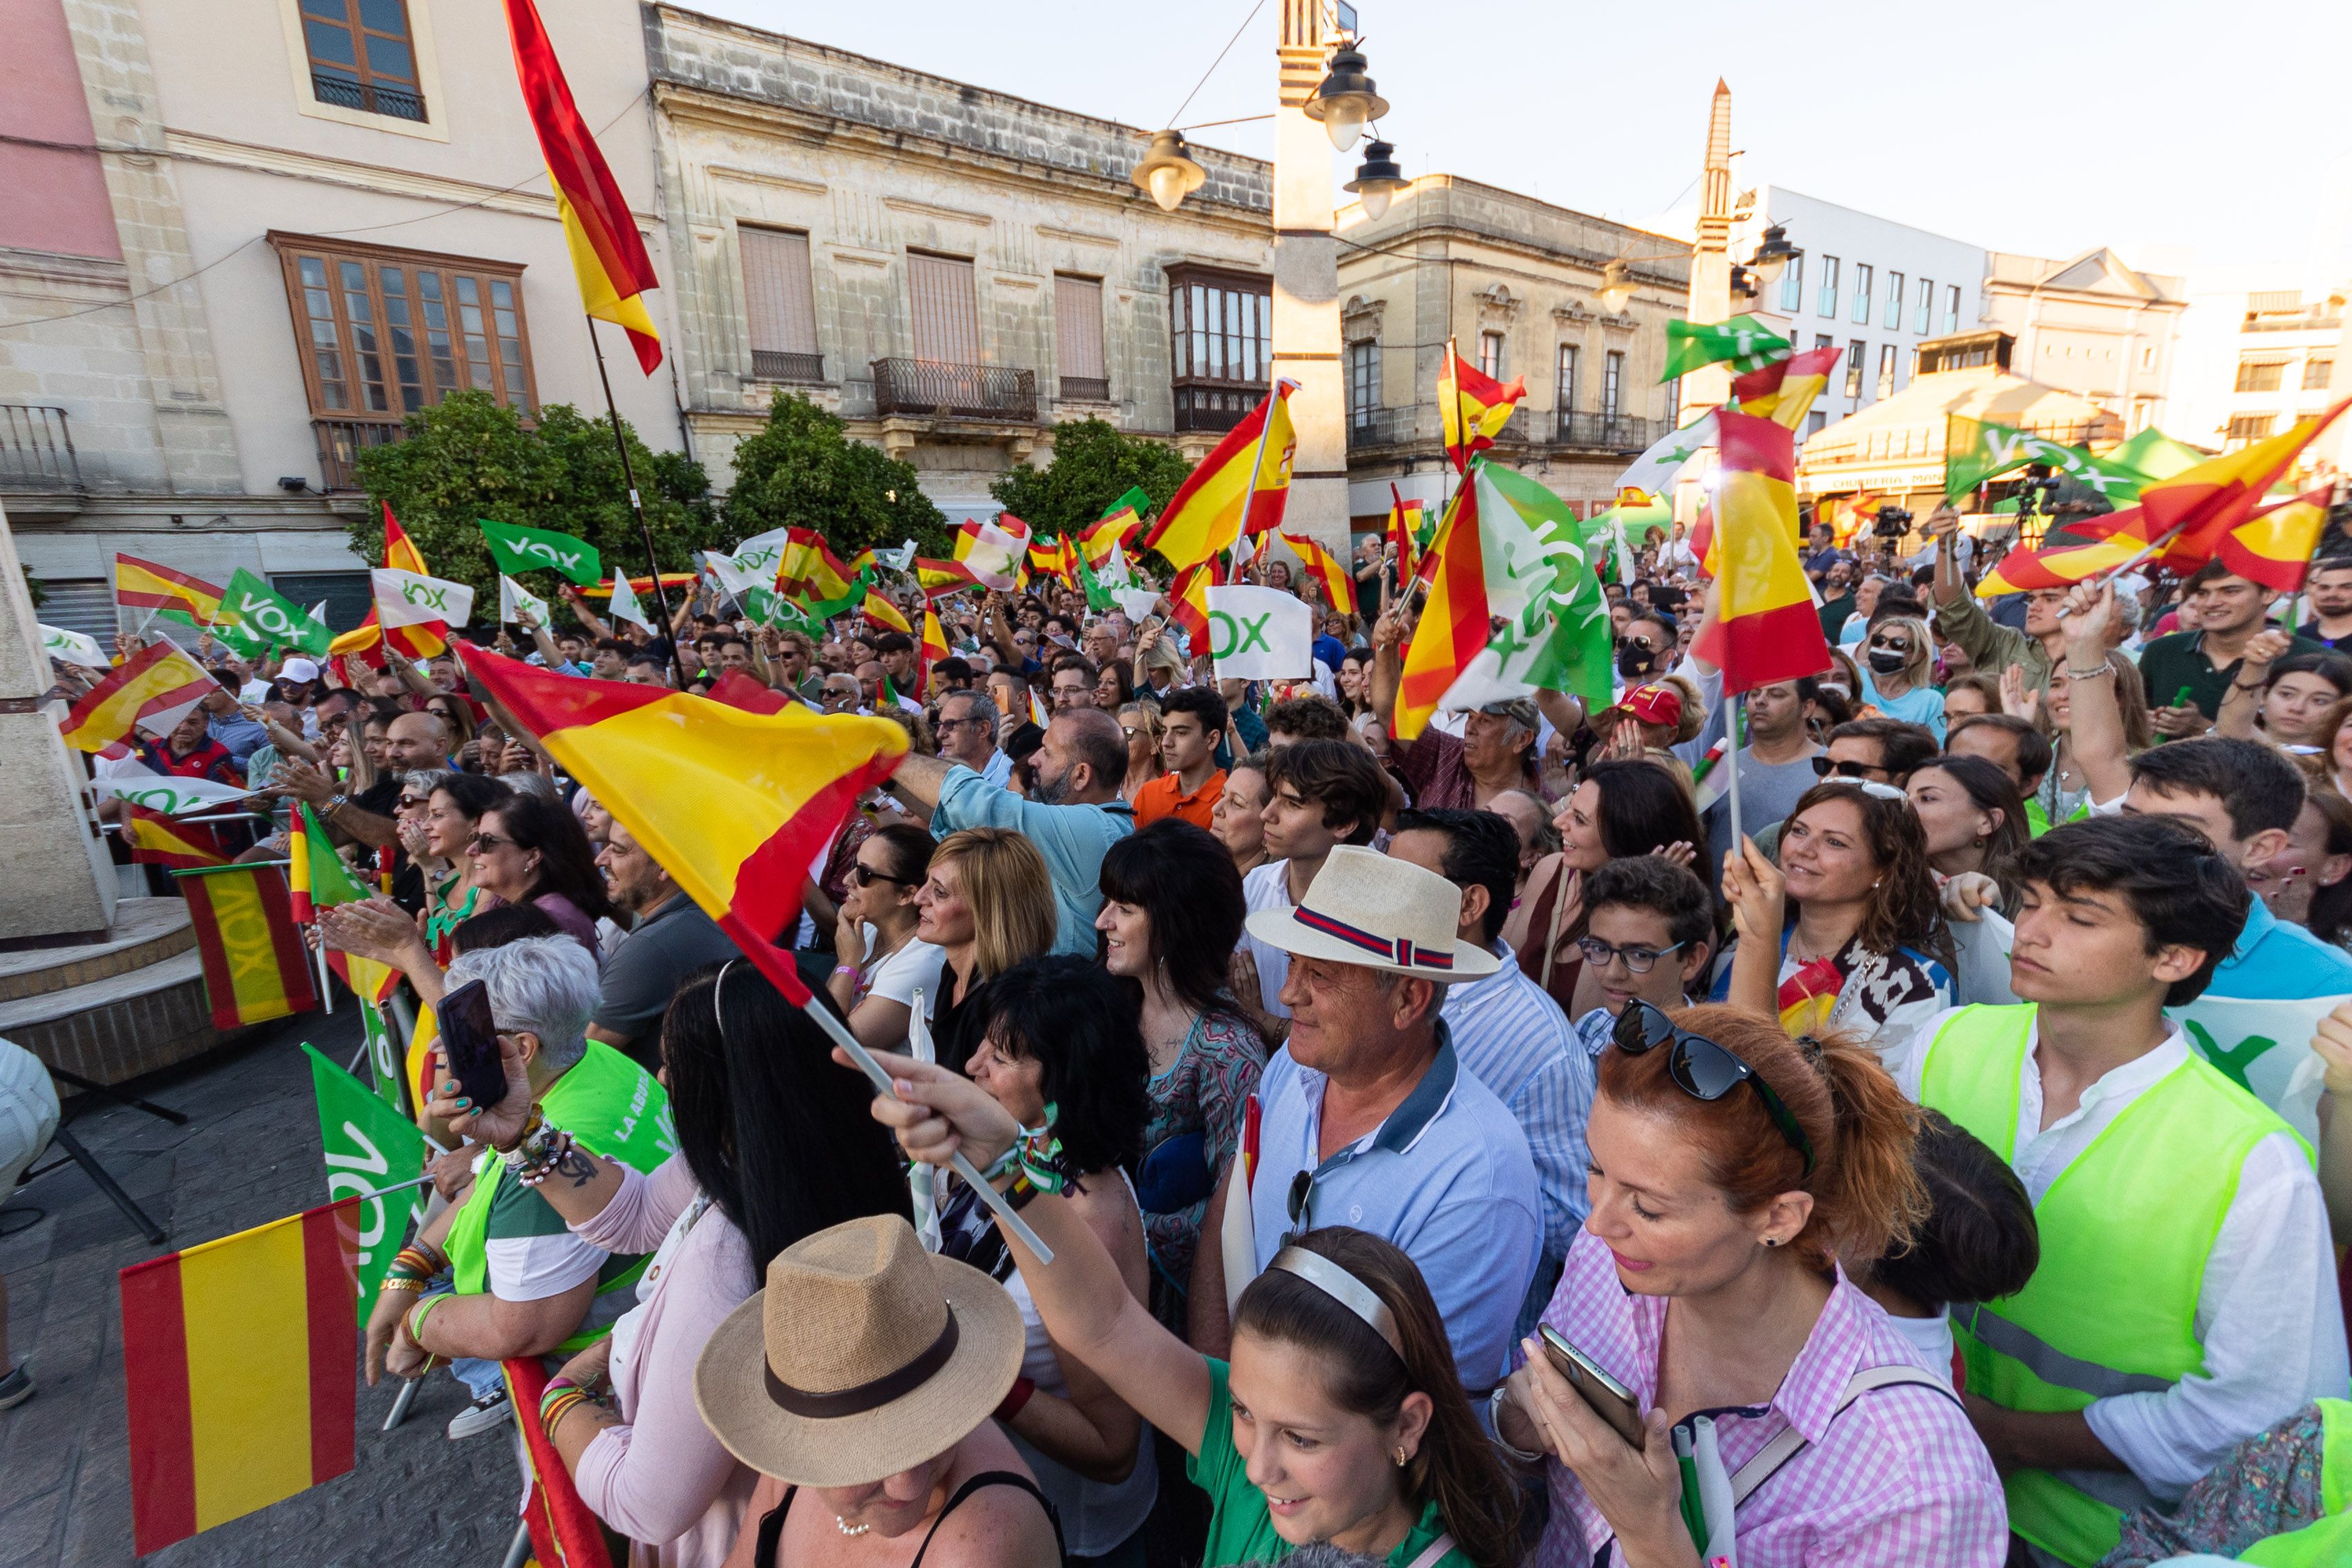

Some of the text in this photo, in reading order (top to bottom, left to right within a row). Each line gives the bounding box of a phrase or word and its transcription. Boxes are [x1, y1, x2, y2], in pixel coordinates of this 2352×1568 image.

[1912, 473, 1942, 482] MAN
[729, 546, 779, 573] VOX
[240, 592, 309, 646] VOX
[614, 1116, 638, 1141] LA
